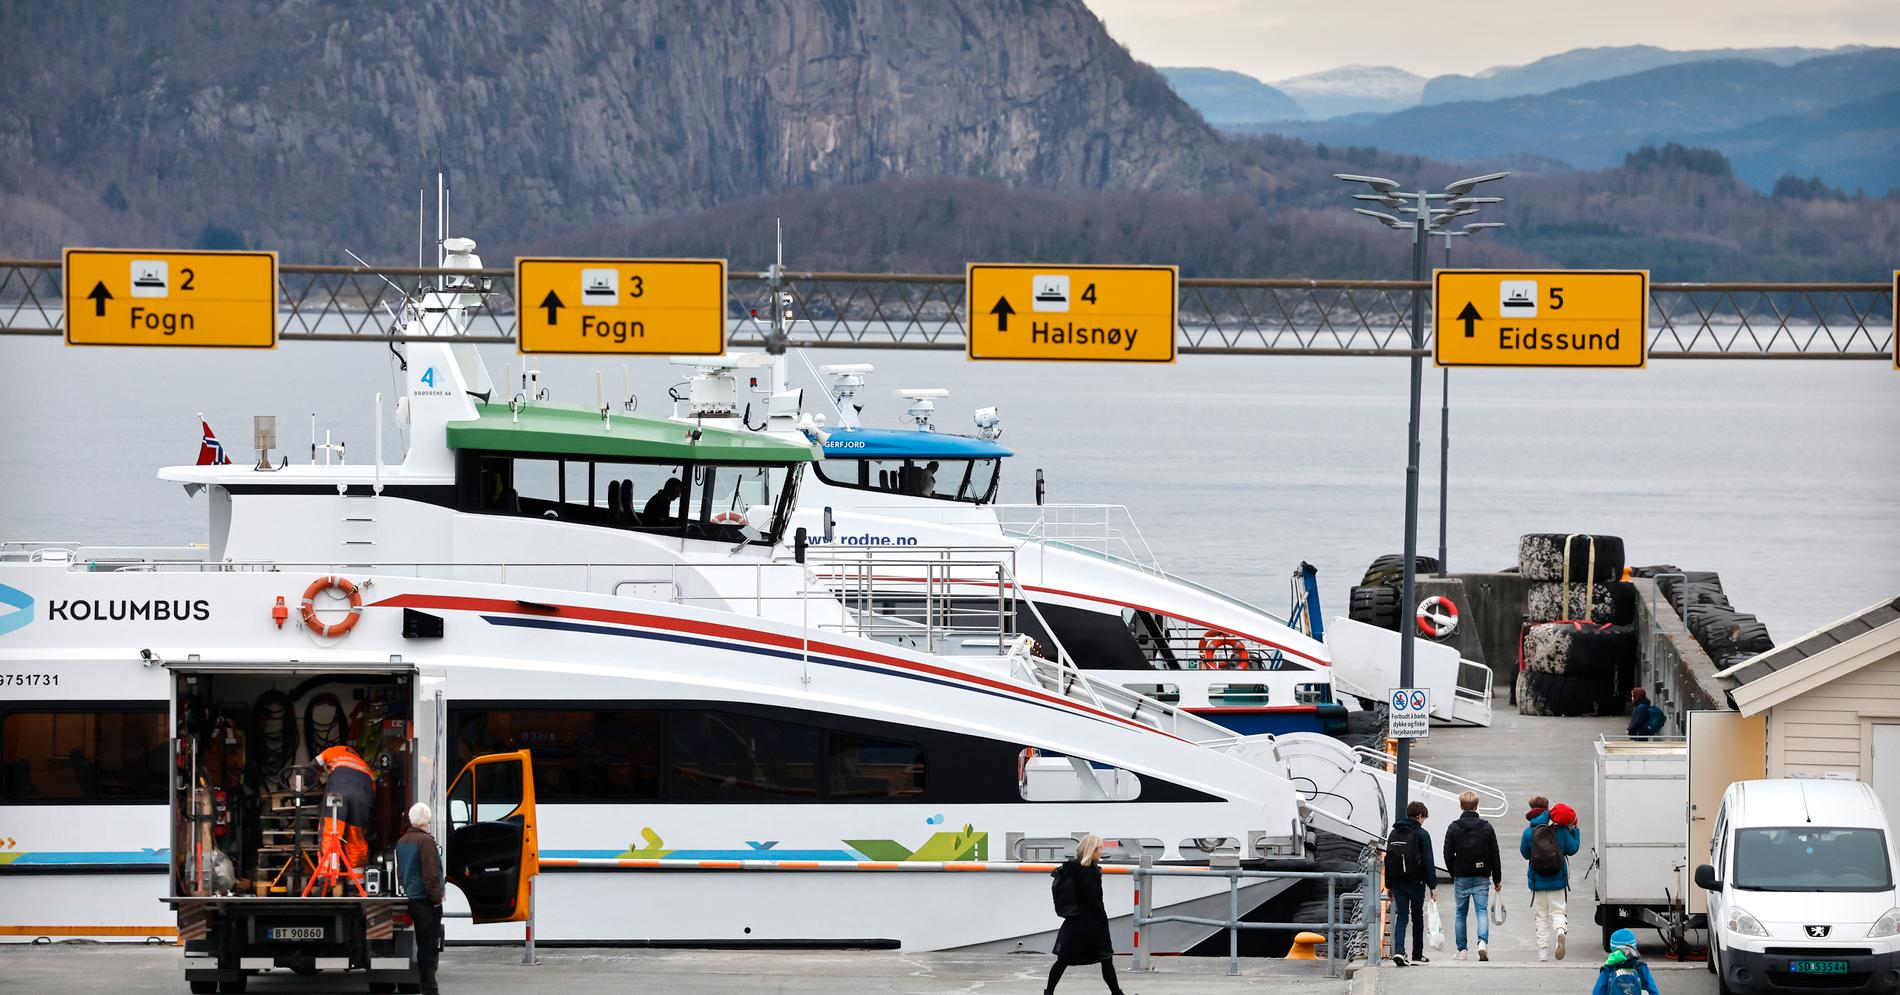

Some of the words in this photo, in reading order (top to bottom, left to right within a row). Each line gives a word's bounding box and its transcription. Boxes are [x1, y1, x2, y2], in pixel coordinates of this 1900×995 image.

[180, 268, 194, 290] 2
[630, 276, 644, 298] 3
[1081, 283, 1097, 305] 4
[1550, 287, 1563, 310] 5
[131, 307, 194, 335] Fogn
[582, 315, 644, 344] Fogn
[1032, 322, 1138, 351] Halsnøy
[1499, 327, 1620, 350] Eidssund
[49, 599, 210, 621] KOLUMBUS
[276, 929, 286, 937] BT
[291, 929, 321, 938] 90860
[1798, 962, 1810, 971] SD
[1816, 962, 1845, 971] 53544
